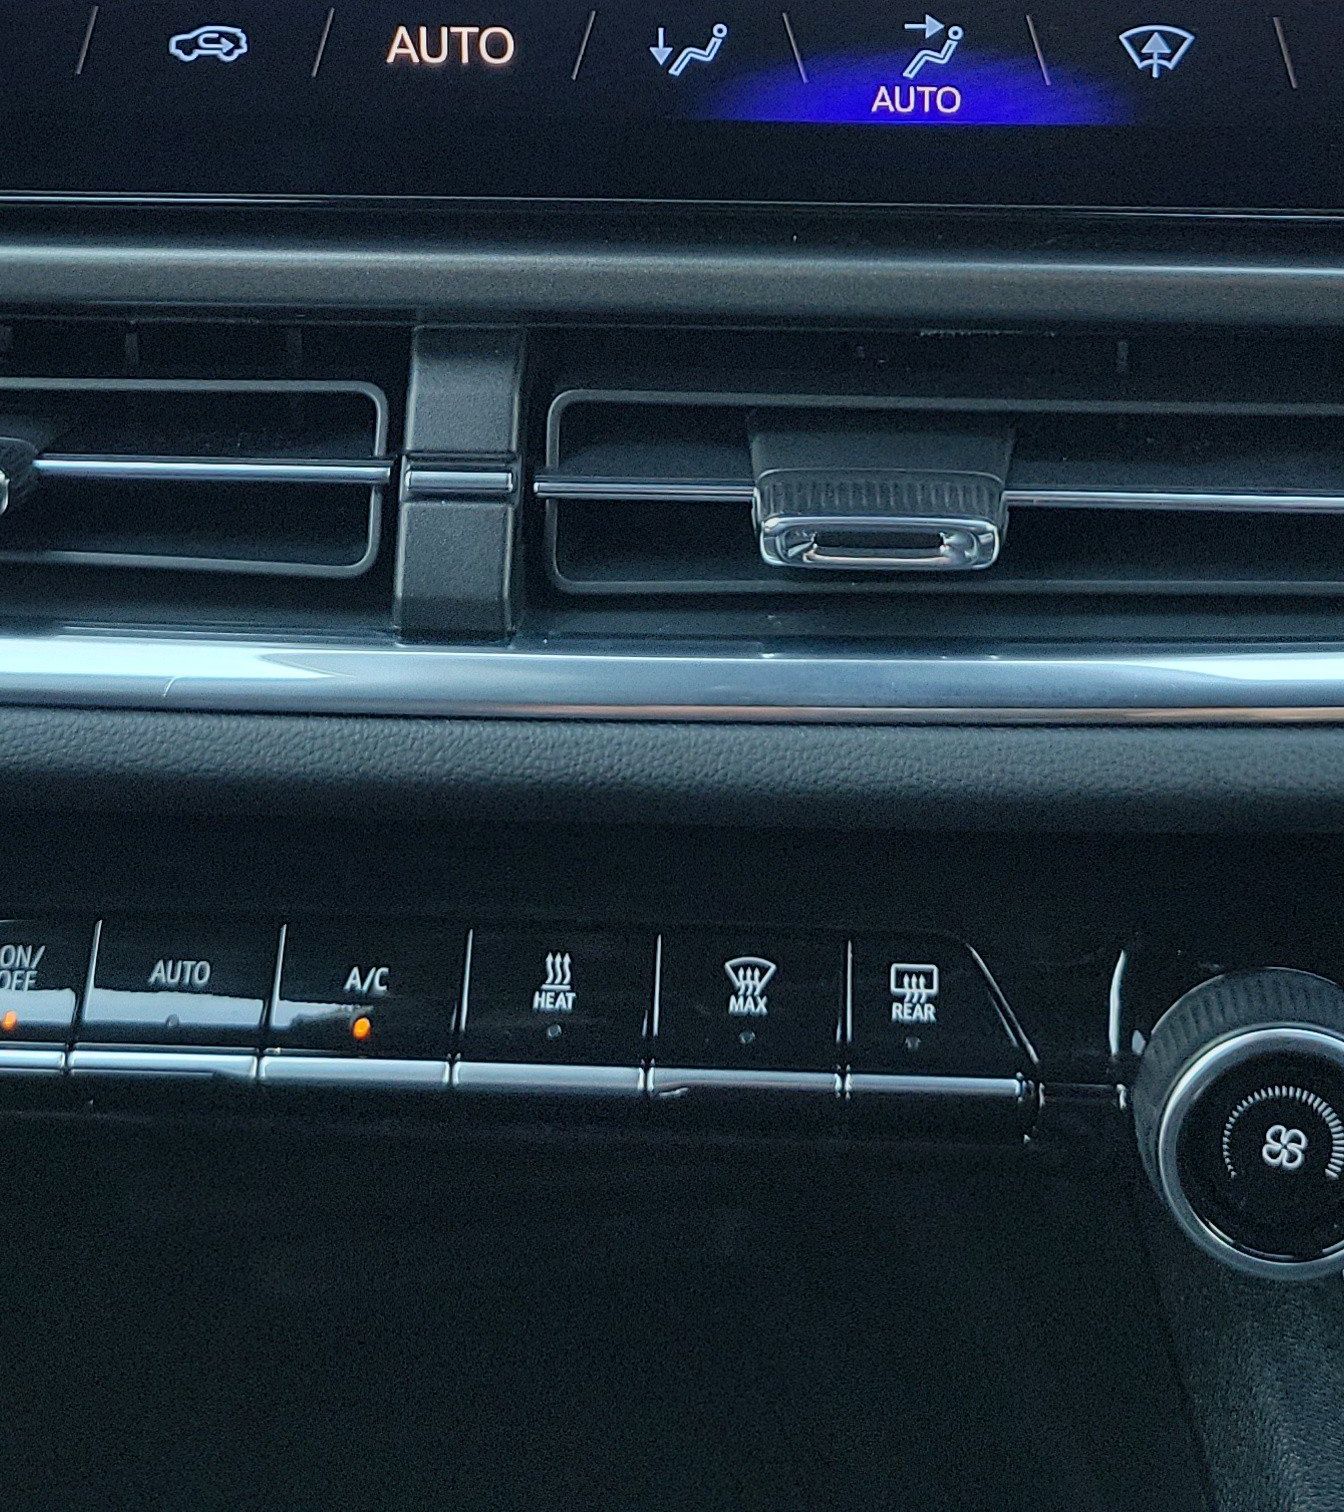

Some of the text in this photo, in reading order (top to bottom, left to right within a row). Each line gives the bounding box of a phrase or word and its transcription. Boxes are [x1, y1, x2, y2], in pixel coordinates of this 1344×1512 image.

[386, 25, 515, 64] AUTO
[871, 87, 962, 114] AUTO
[149, 960, 211, 986] AUTO
[343, 966, 389, 993] A/C
[532, 990, 576, 1012] HEAT
[728, 995, 768, 1015] MAX
[891, 1002, 936, 1023] REAR
